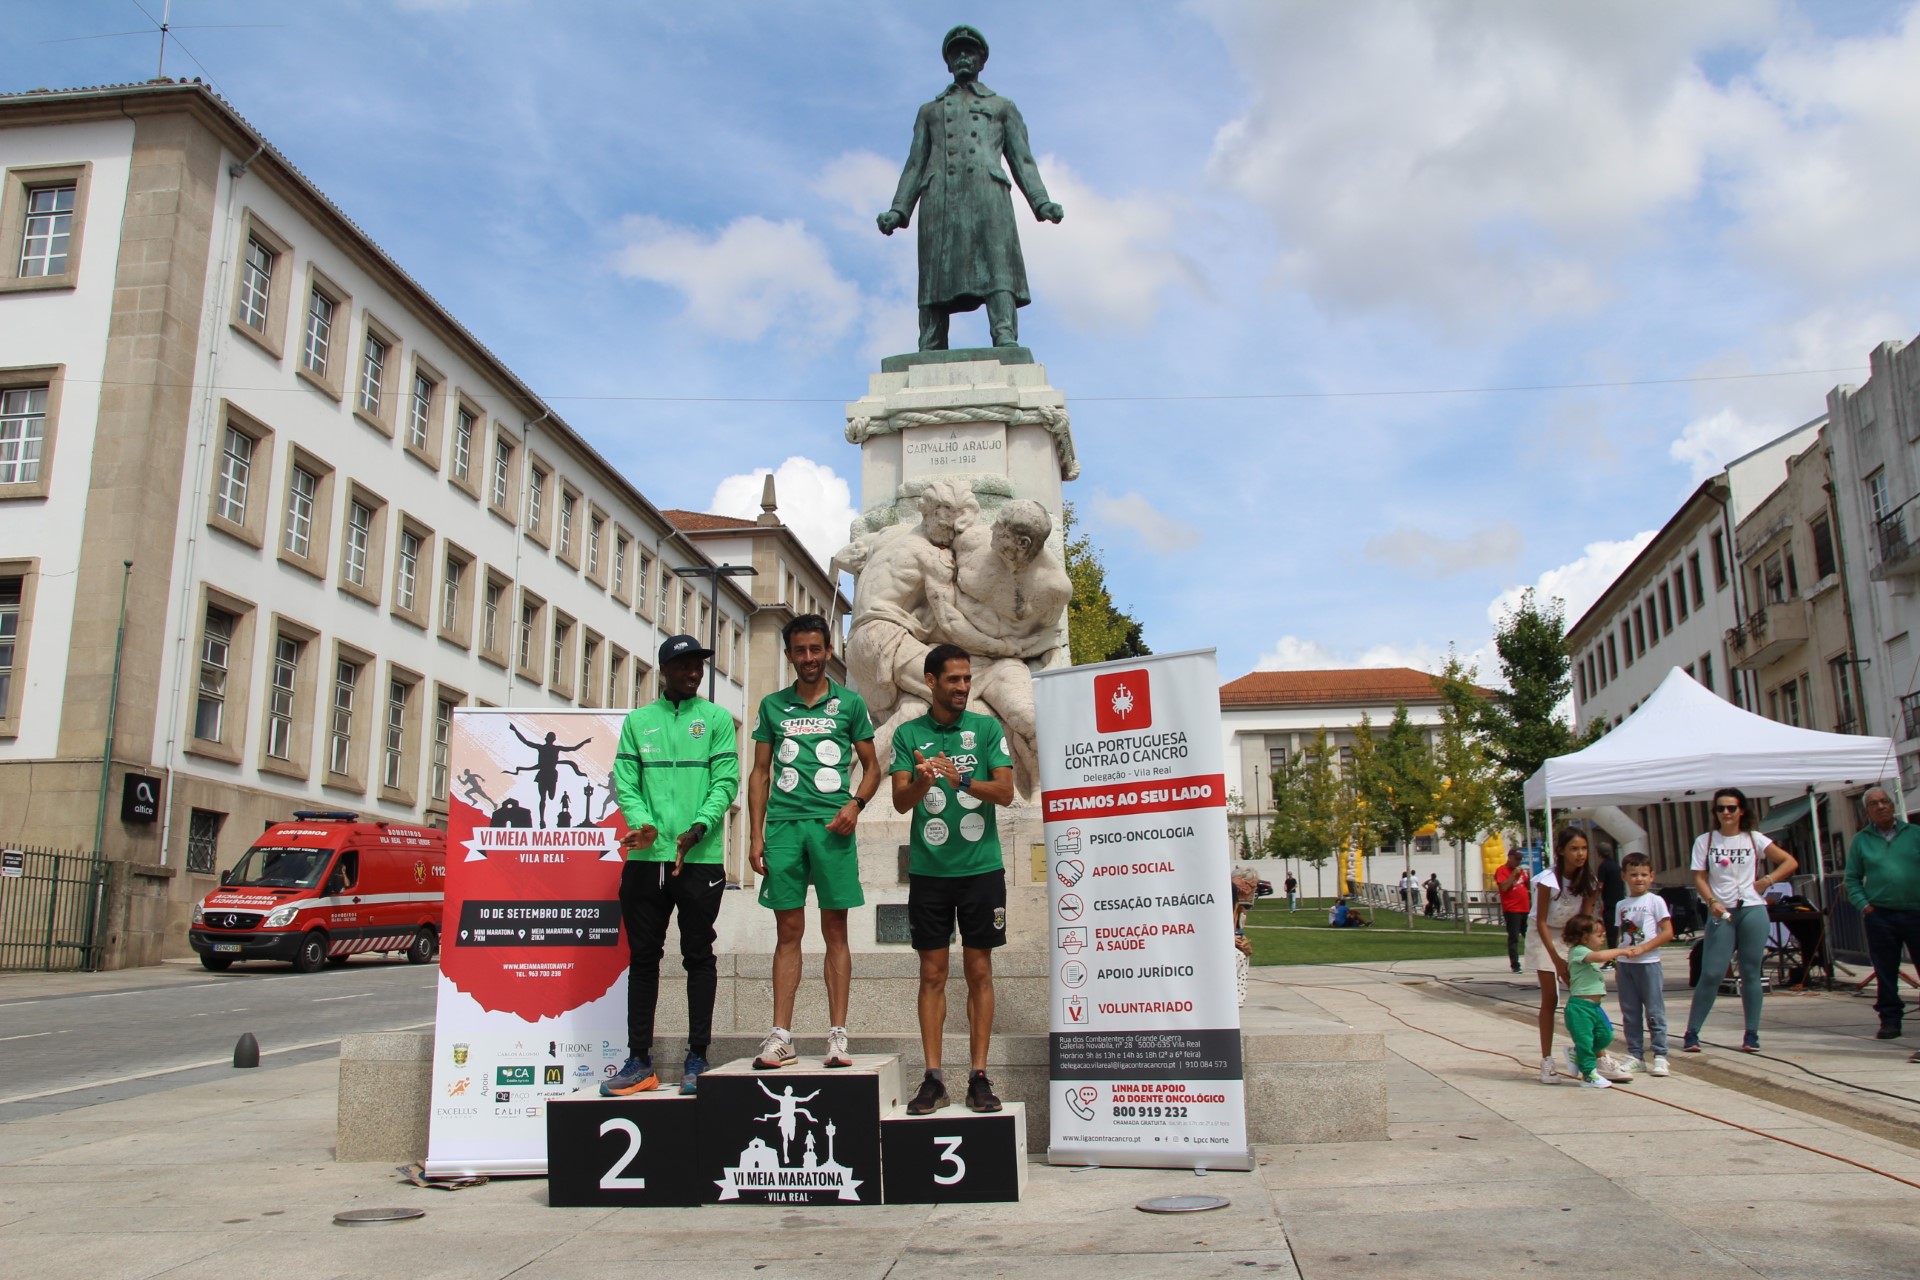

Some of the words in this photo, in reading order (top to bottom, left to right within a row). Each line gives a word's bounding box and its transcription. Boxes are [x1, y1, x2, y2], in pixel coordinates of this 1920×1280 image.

[906, 441, 958, 454] CARVALHO
[962, 440, 1002, 451] ARAUJO
[781, 719, 835, 727] CHINCA
[1065, 742, 1094, 757] LIGA
[1098, 731, 1187, 753] PORTUGUESA
[1065, 754, 1119, 770] CONTRA
[1120, 752, 1130, 764] O
[1132, 746, 1188, 763] CANCRO
[1083, 771, 1126, 783] Delegação
[1134, 768, 1151, 777] Vila
[1153, 766, 1172, 776] Real
[1049, 795, 1115, 813] ESTAMOS
[1117, 791, 1138, 806] AO
[1140, 788, 1169, 804] SEU
[1172, 785, 1212, 801] LADO
[134, 805, 153, 815] altice
[387, 829, 422, 837] BOMBEIROS
[1089, 826, 1194, 845] PSICO-ONCOLOGIA
[480, 830, 493, 846] VI
[495, 831, 528, 846] MEIA
[532, 831, 606, 847] MARATONA
[1710, 848, 1751, 856] FLUFFY
[520, 853, 540, 863] VILA
[543, 853, 565, 863] REAL
[1715, 856, 1745, 865] LVE
[1092, 864, 1129, 877] APOIO
[1132, 861, 1175, 875] SOCIAL
[1093, 896, 1152, 912] CESSAÇÃO
[1155, 893, 1215, 907] TABÁGICA
[480, 908, 490, 919] 10
[492, 908, 504, 919] DE
[507, 908, 558, 919] SETEMBRO
[561, 908, 573, 919] DE
[575, 908, 600, 919] 2023
[546, 927, 574, 935] MARATONA
[1095, 924, 1158, 939] EDUCAÇÃO
[1161, 923, 1195, 935] PARA
[1096, 941, 1105, 952] A
[1107, 938, 1146, 951] SAÚDE
[1097, 968, 1134, 980] APOIO
[1137, 964, 1194, 979] JURÍDICO
[1098, 1001, 1193, 1014] VOLUNTARIADO
[1085, 1035, 1125, 1043] Combatentes
[1135, 1034, 1157, 1042] Grande
[1159, 1034, 1182, 1042] Guerra
[558, 1043, 592, 1053] TIRONE
[1138, 1041, 1171, 1049] 5000-635
[1186, 1040, 1201, 1048] Real
[1122, 1051, 1134, 1059] 14h
[1183, 1051, 1201, 1059] feira)
[1214, 1060, 1228, 1068] 573
[514, 1068, 530, 1078] CA
[1111, 1084, 1140, 1093] LINHA
[1141, 1084, 1154, 1093] DE
[1155, 1084, 1186, 1093] APOIO
[1112, 1094, 1126, 1103] AO
[1127, 1094, 1164, 1103] DOENTE
[1165, 1093, 1225, 1103] ONCOLÓGICO
[437, 1108, 478, 1116] EXCELLUS
[1113, 1106, 1136, 1117] 800
[1138, 1106, 1162, 1117] 919
[1164, 1106, 1188, 1118] 232
[1062, 1135, 1141, 1143] www.ligacontracancro.pt
[1193, 1136, 1209, 1144] Lpcc
[1209, 1136, 1229, 1144] Norte
[599, 1118, 645, 1190] 2
[933, 1135, 966, 1186] 3
[733, 1171, 744, 1186] VI
[747, 1171, 776, 1186] MEIA
[778, 1171, 844, 1187] MARATONA
[768, 1192, 787, 1202] VILA
[788, 1192, 809, 1202] REAL
